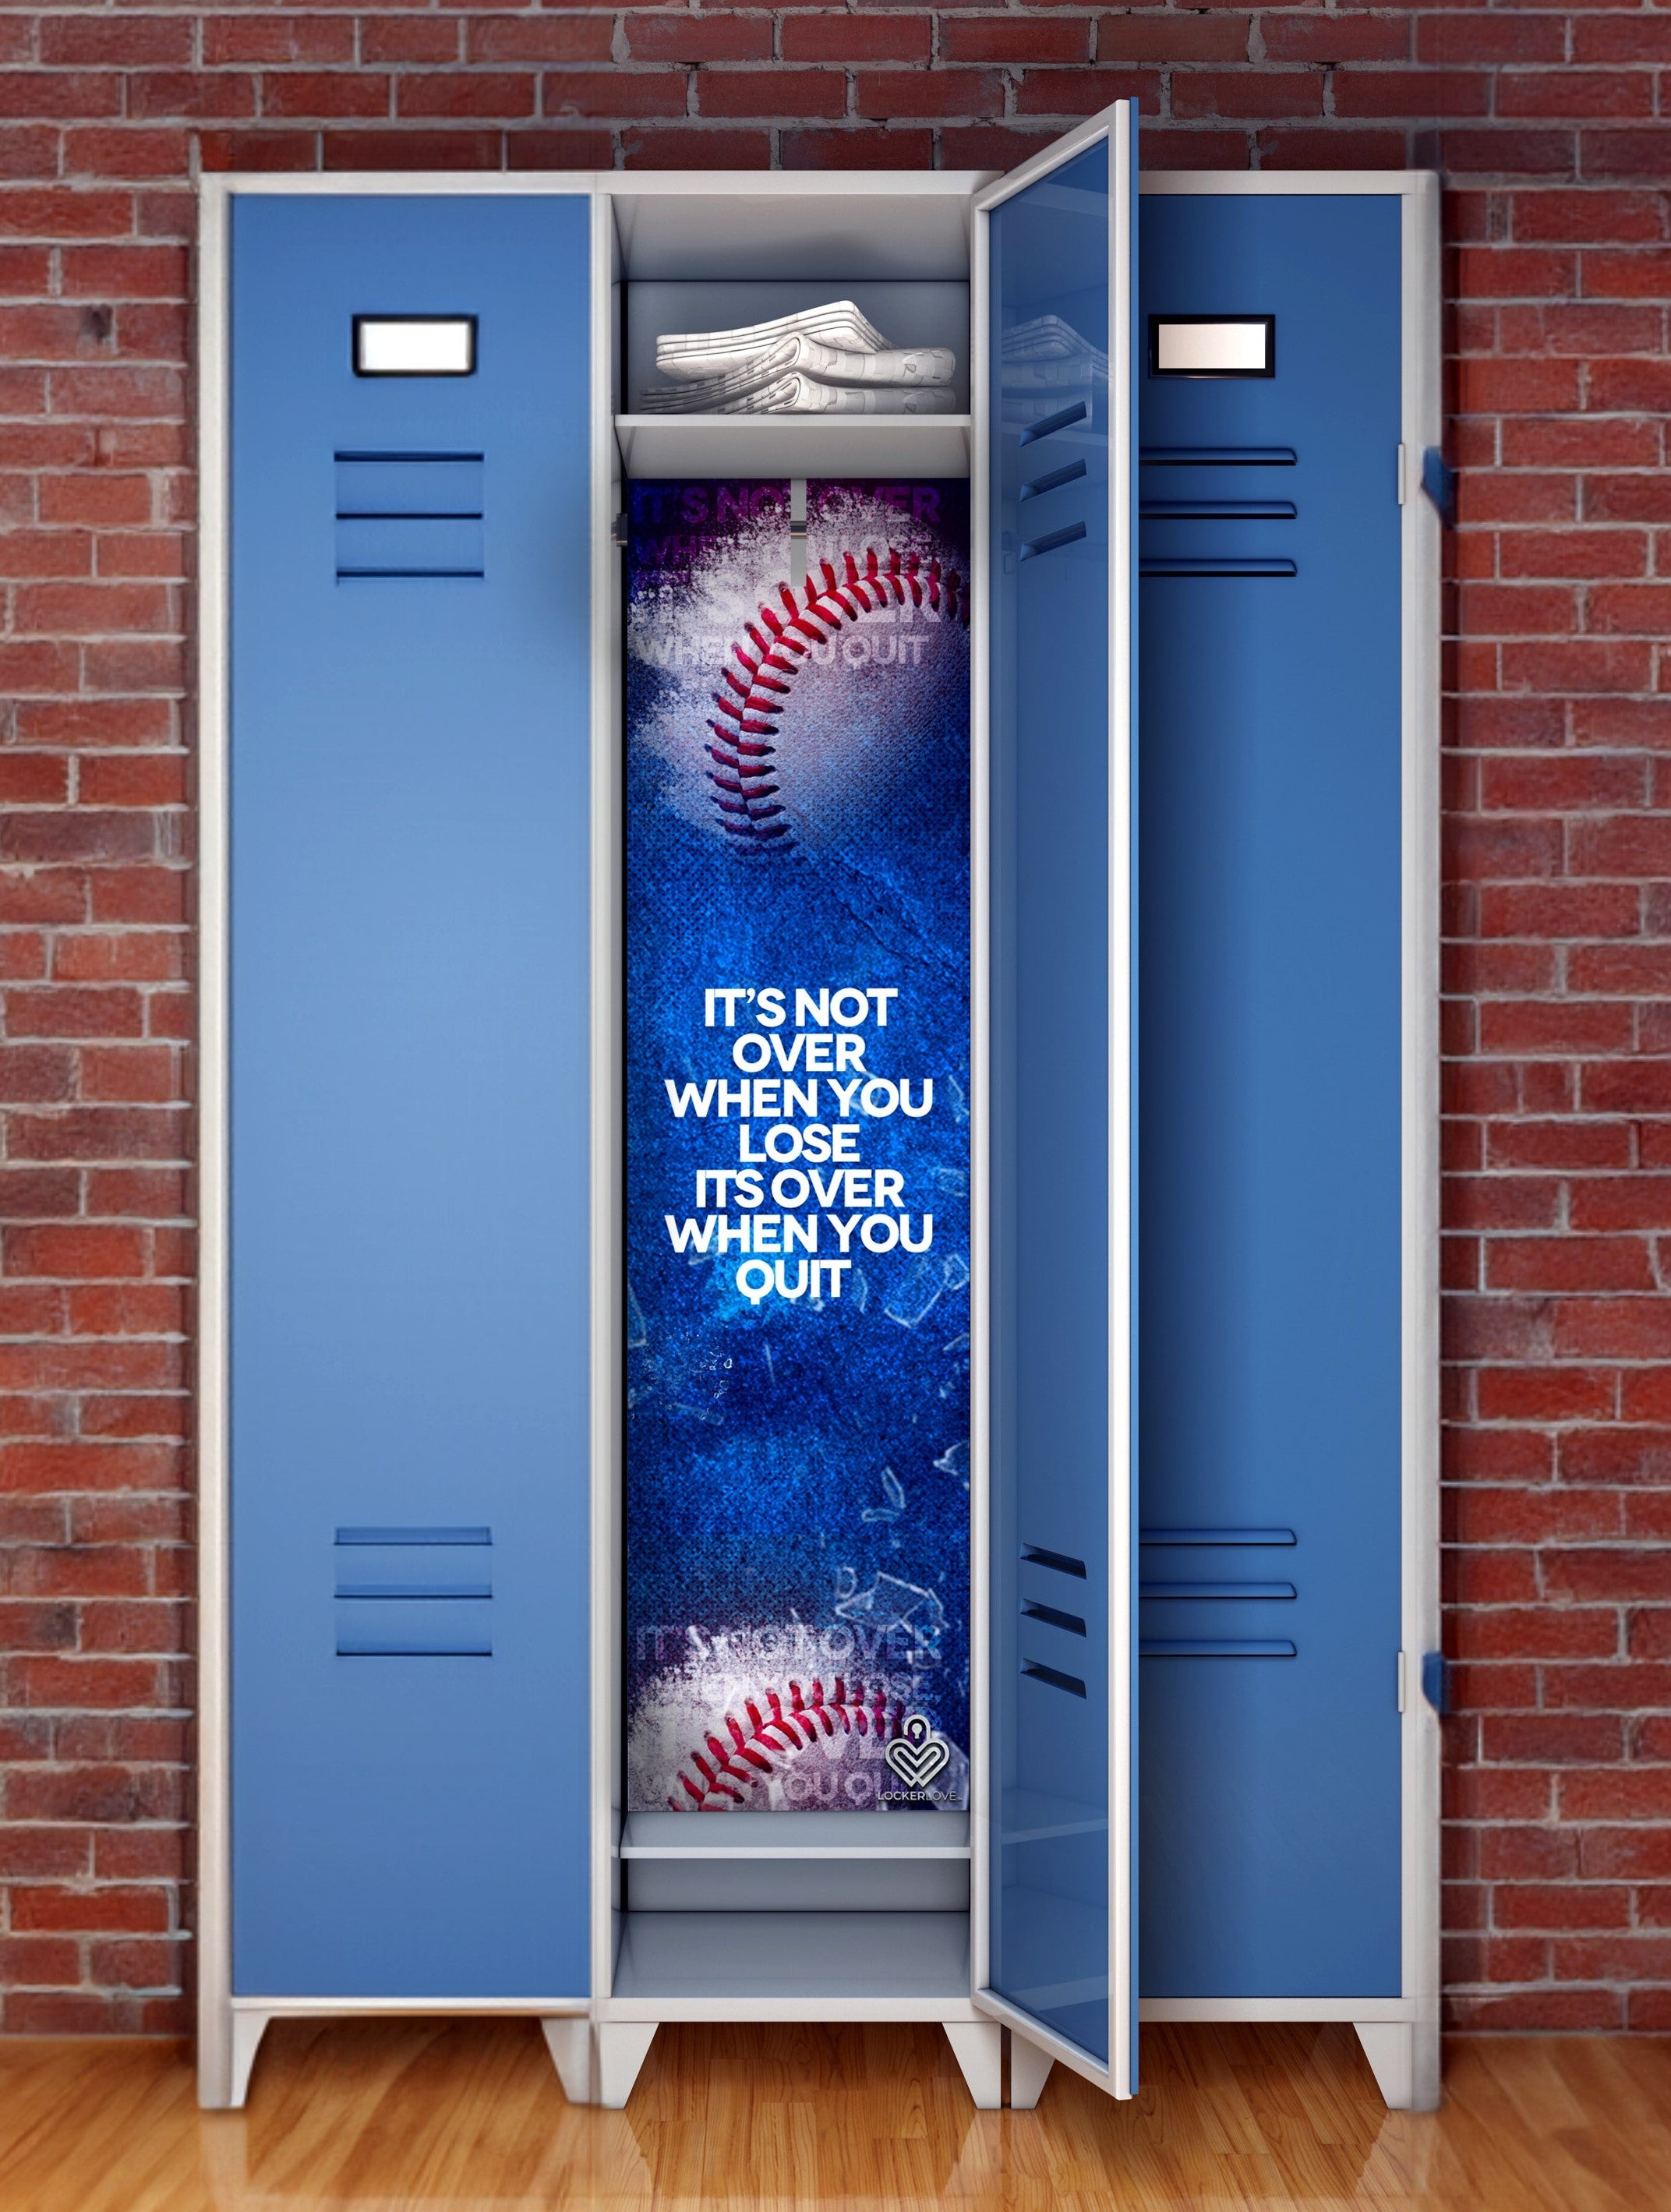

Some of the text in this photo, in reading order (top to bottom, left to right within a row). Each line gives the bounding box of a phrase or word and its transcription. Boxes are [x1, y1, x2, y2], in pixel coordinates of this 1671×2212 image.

[843, 634, 930, 670] QUIT
[705, 988, 898, 1027] IT’S NOT
[733, 1033, 867, 1073] OVER
[664, 1078, 933, 1118] WHEN YOU
[740, 1124, 860, 1163] LOSE
[696, 1169, 905, 1208] ITS OVER
[664, 1214, 933, 1253] WHEN YOU
[736, 1259, 852, 1306] QUIT
[819, 1624, 942, 1661] OVER
[878, 1791, 957, 1801] LOCKERLOVE
